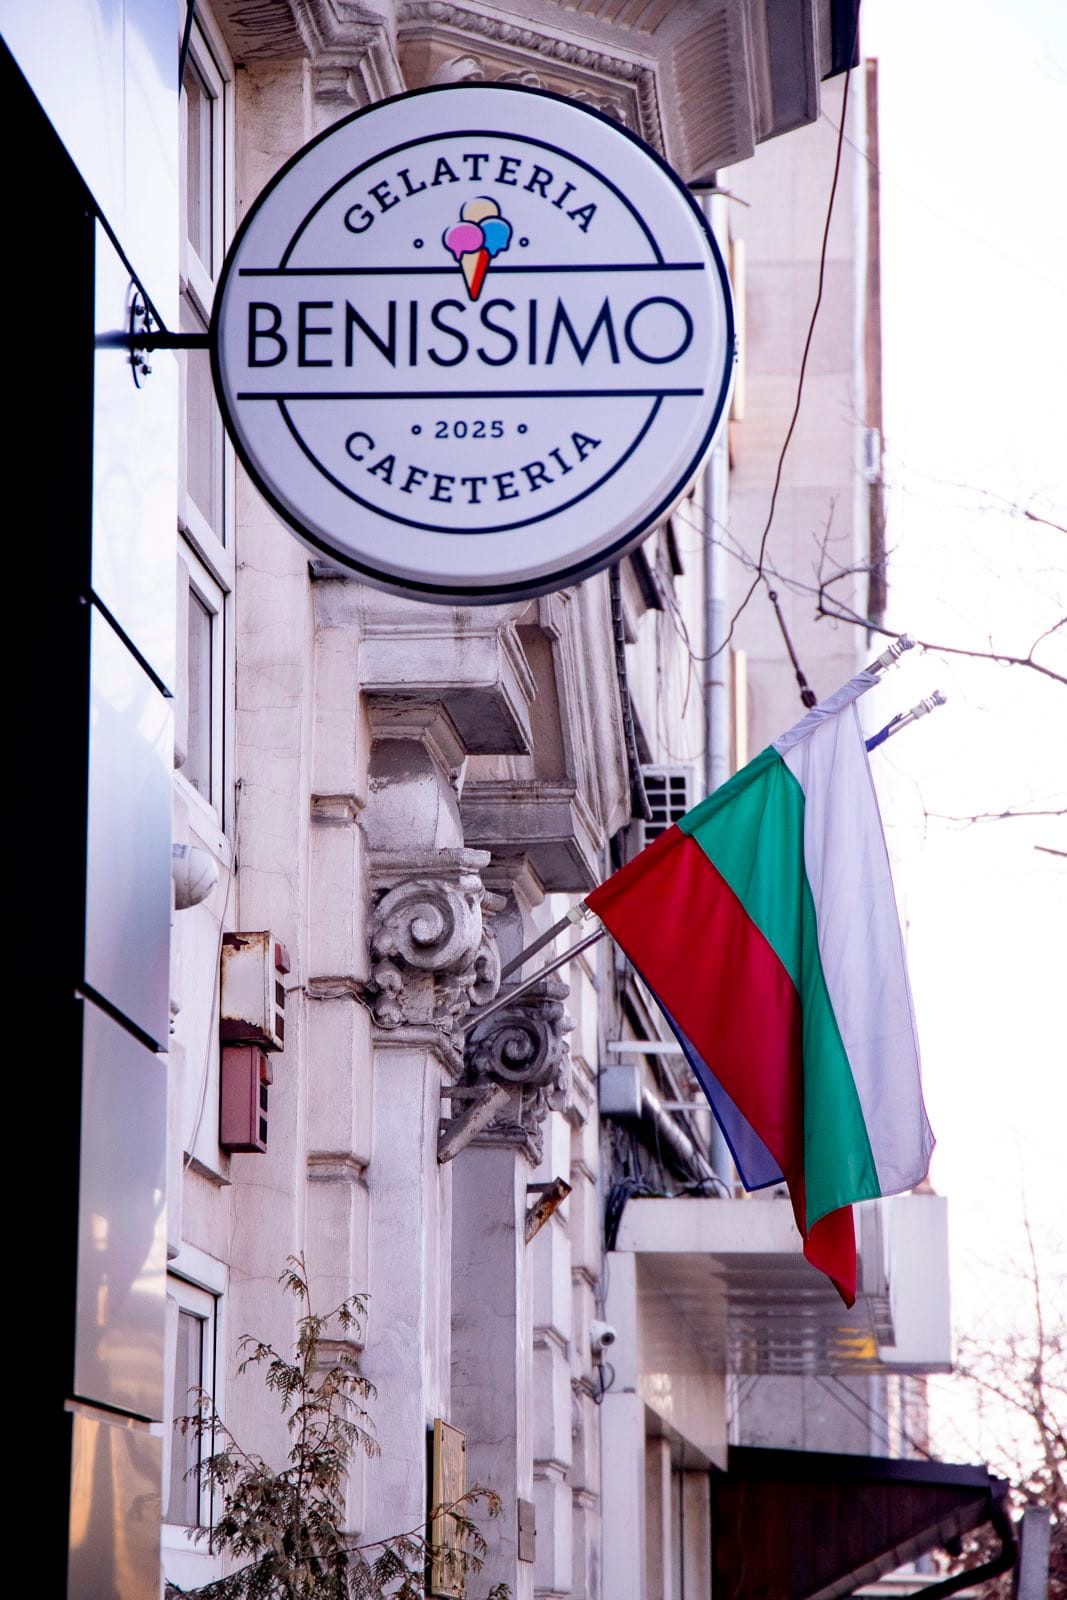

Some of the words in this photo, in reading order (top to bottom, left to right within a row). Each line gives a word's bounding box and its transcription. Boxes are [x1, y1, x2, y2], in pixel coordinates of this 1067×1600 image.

[343, 153, 598, 235] GELATERIA
[247, 296, 695, 369] BENISSIMO
[434, 420, 504, 439] 2025
[344, 431, 602, 505] CAFETERIA
